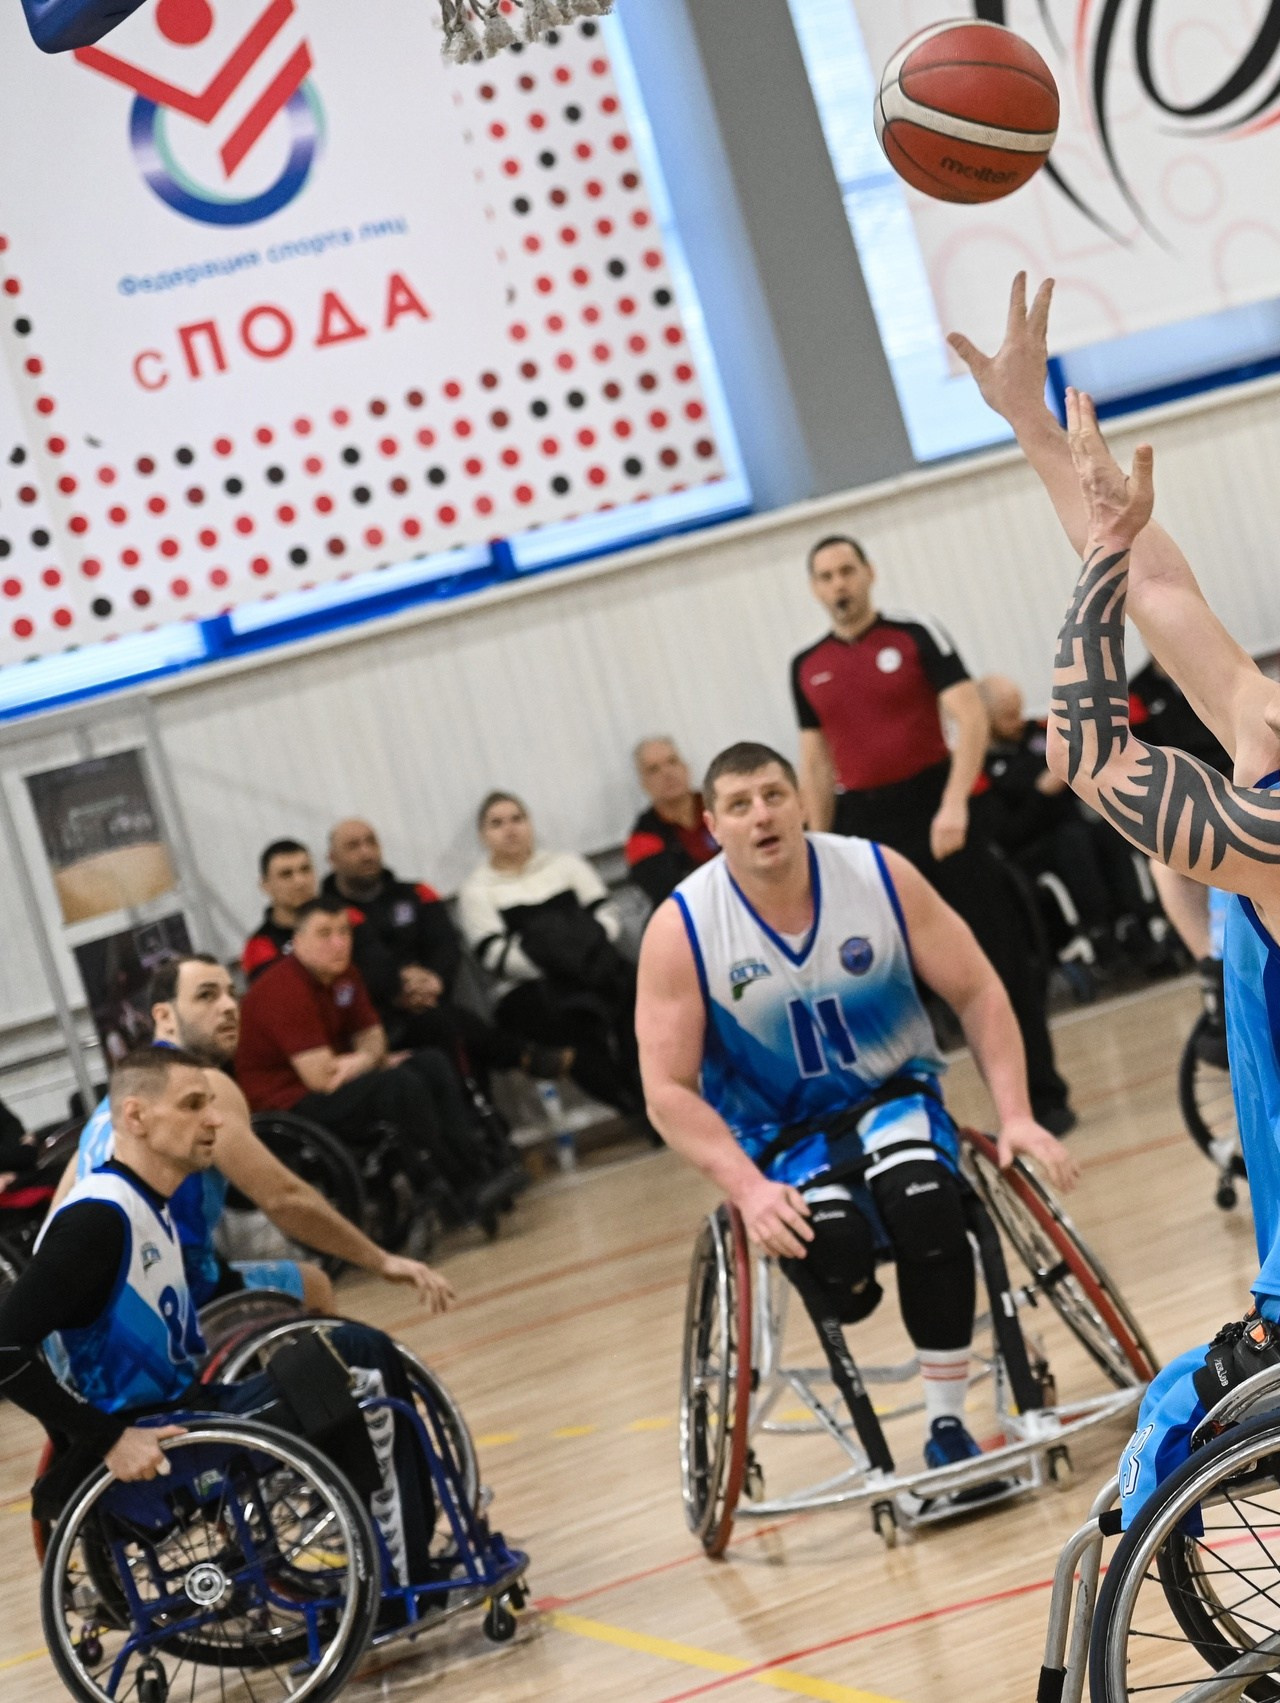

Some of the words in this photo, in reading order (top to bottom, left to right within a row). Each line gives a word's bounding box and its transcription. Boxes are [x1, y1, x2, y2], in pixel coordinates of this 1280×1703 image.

[940, 156, 1018, 183] molten
[118, 251, 261, 296] Федерация
[266, 226, 353, 263] спорта
[358, 217, 409, 240] лиц
